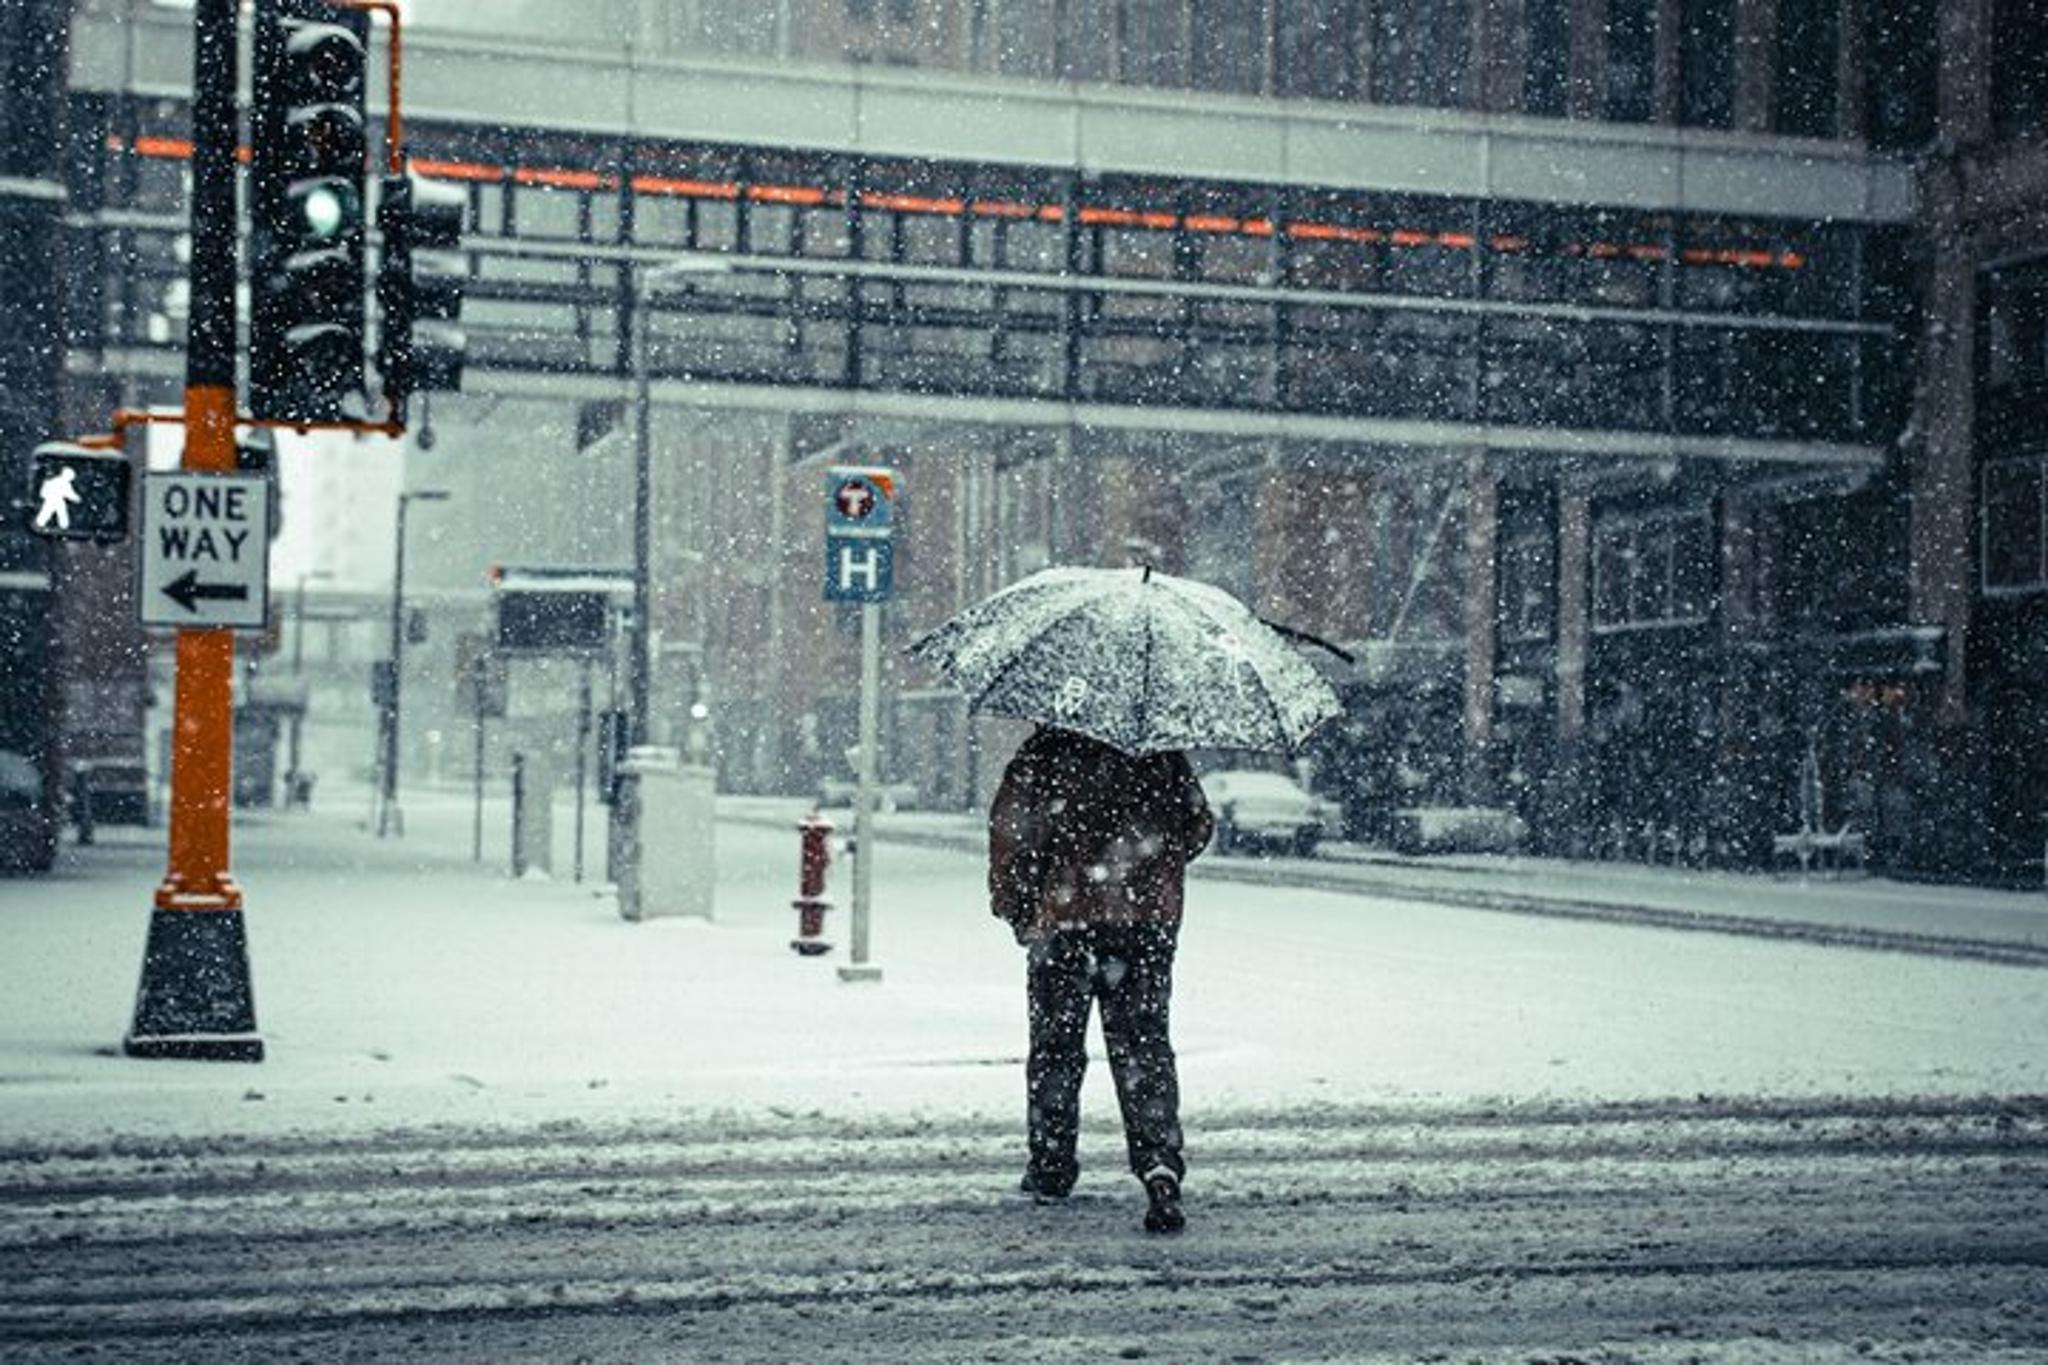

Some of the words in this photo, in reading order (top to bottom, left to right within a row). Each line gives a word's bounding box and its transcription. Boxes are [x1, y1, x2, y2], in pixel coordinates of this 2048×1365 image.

[164, 484, 248, 520] ONE
[160, 526, 248, 562] WAY
[841, 547, 877, 590] H
